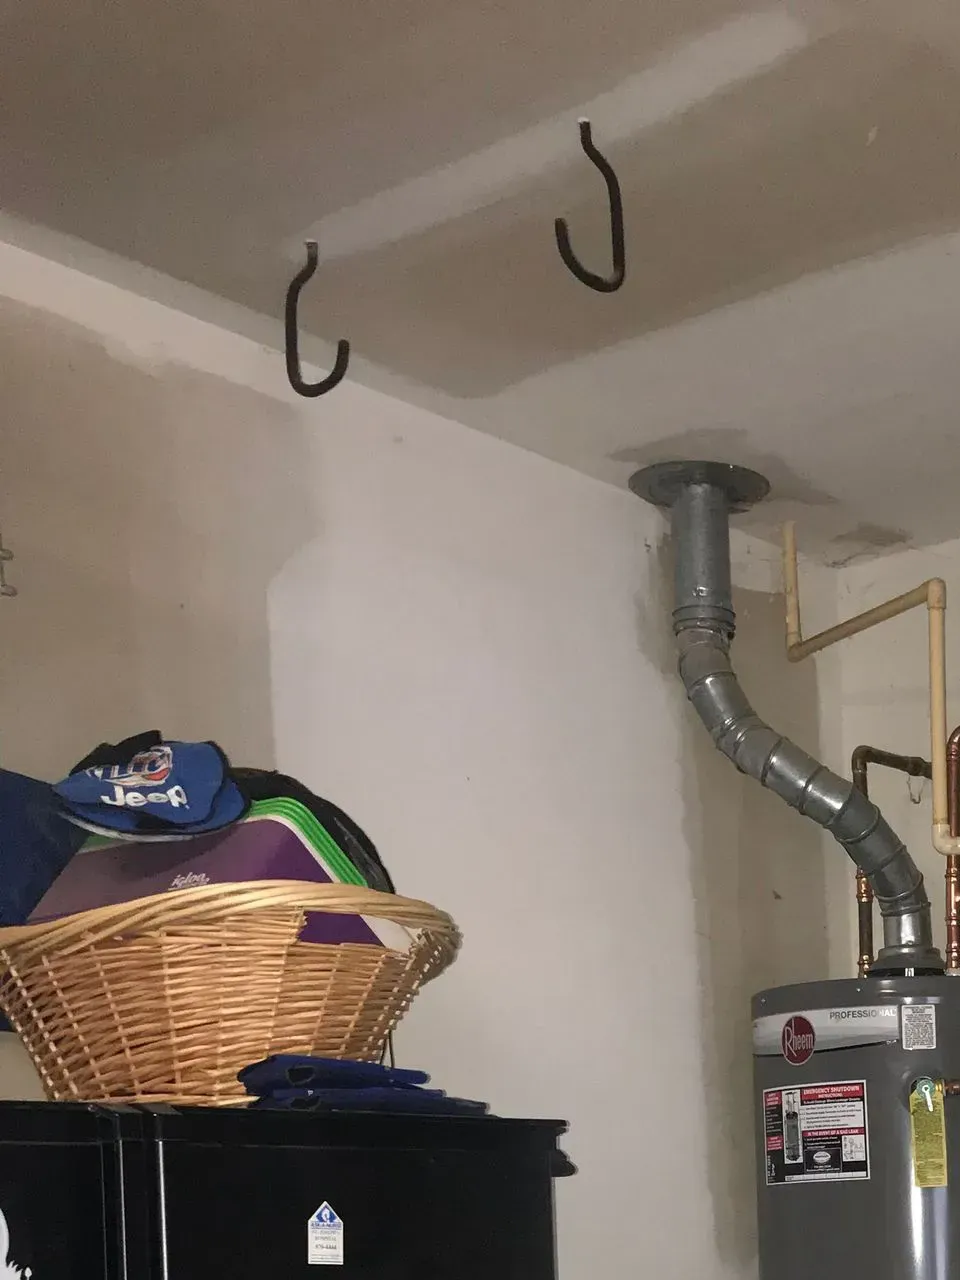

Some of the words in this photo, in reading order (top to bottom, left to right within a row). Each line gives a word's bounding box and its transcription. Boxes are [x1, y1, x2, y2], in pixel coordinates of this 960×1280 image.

[100, 785, 188, 808] Jeep
[829, 1008, 897, 1020] PROFESSIONAL
[784, 1018, 813, 1056] Rheem
